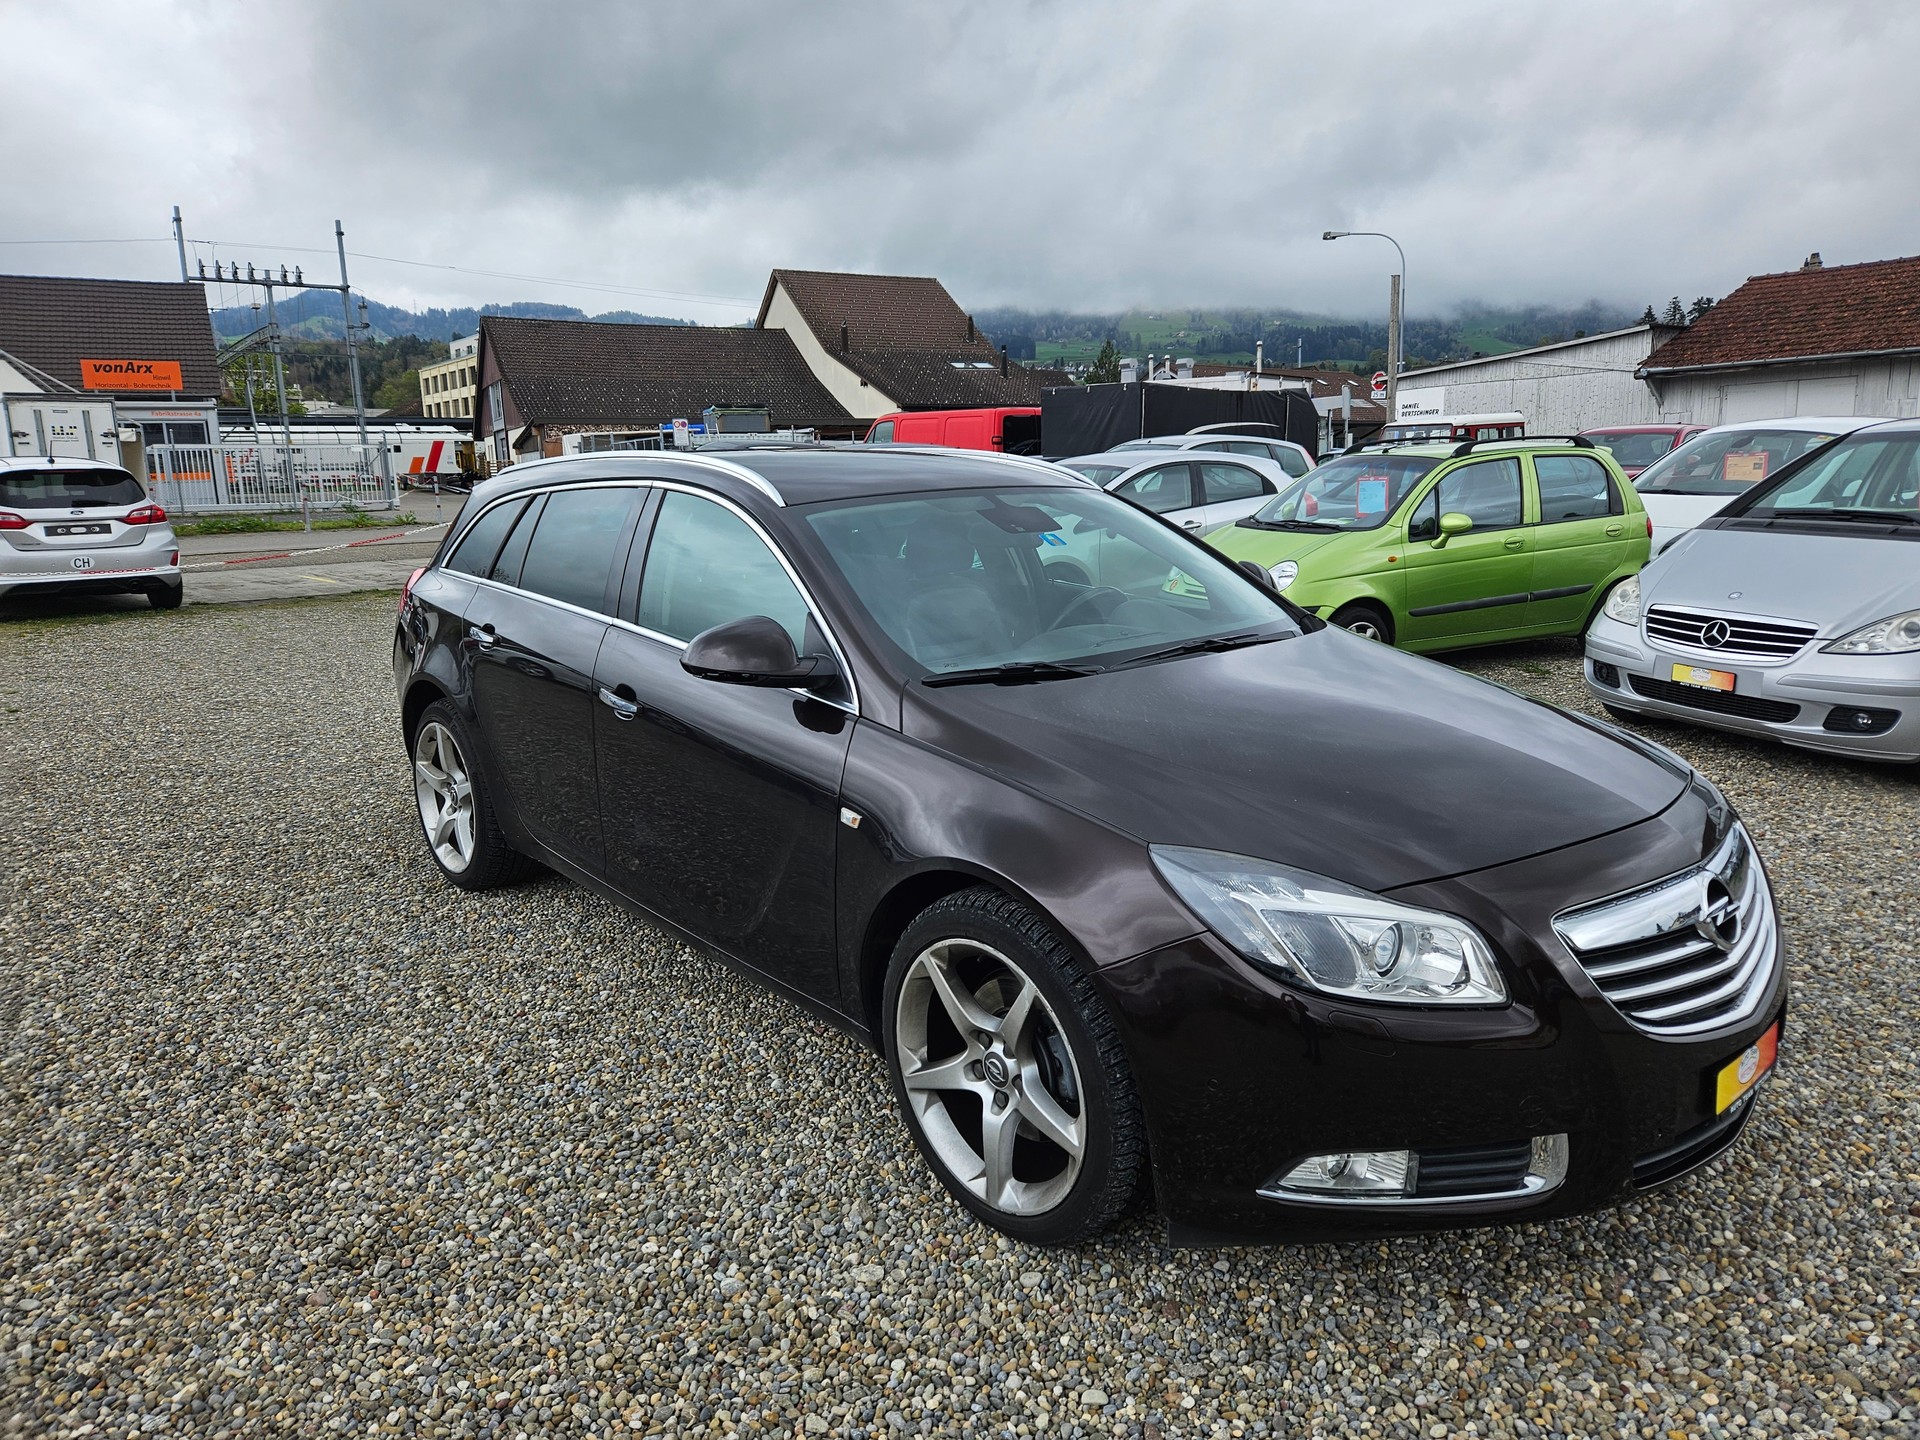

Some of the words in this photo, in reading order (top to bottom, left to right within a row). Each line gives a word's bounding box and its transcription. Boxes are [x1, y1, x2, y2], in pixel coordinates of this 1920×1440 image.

[93, 361, 153, 373] vonArx
[1401, 409, 1439, 417] BERTSCHINGER
[74, 558, 90, 568] CH
